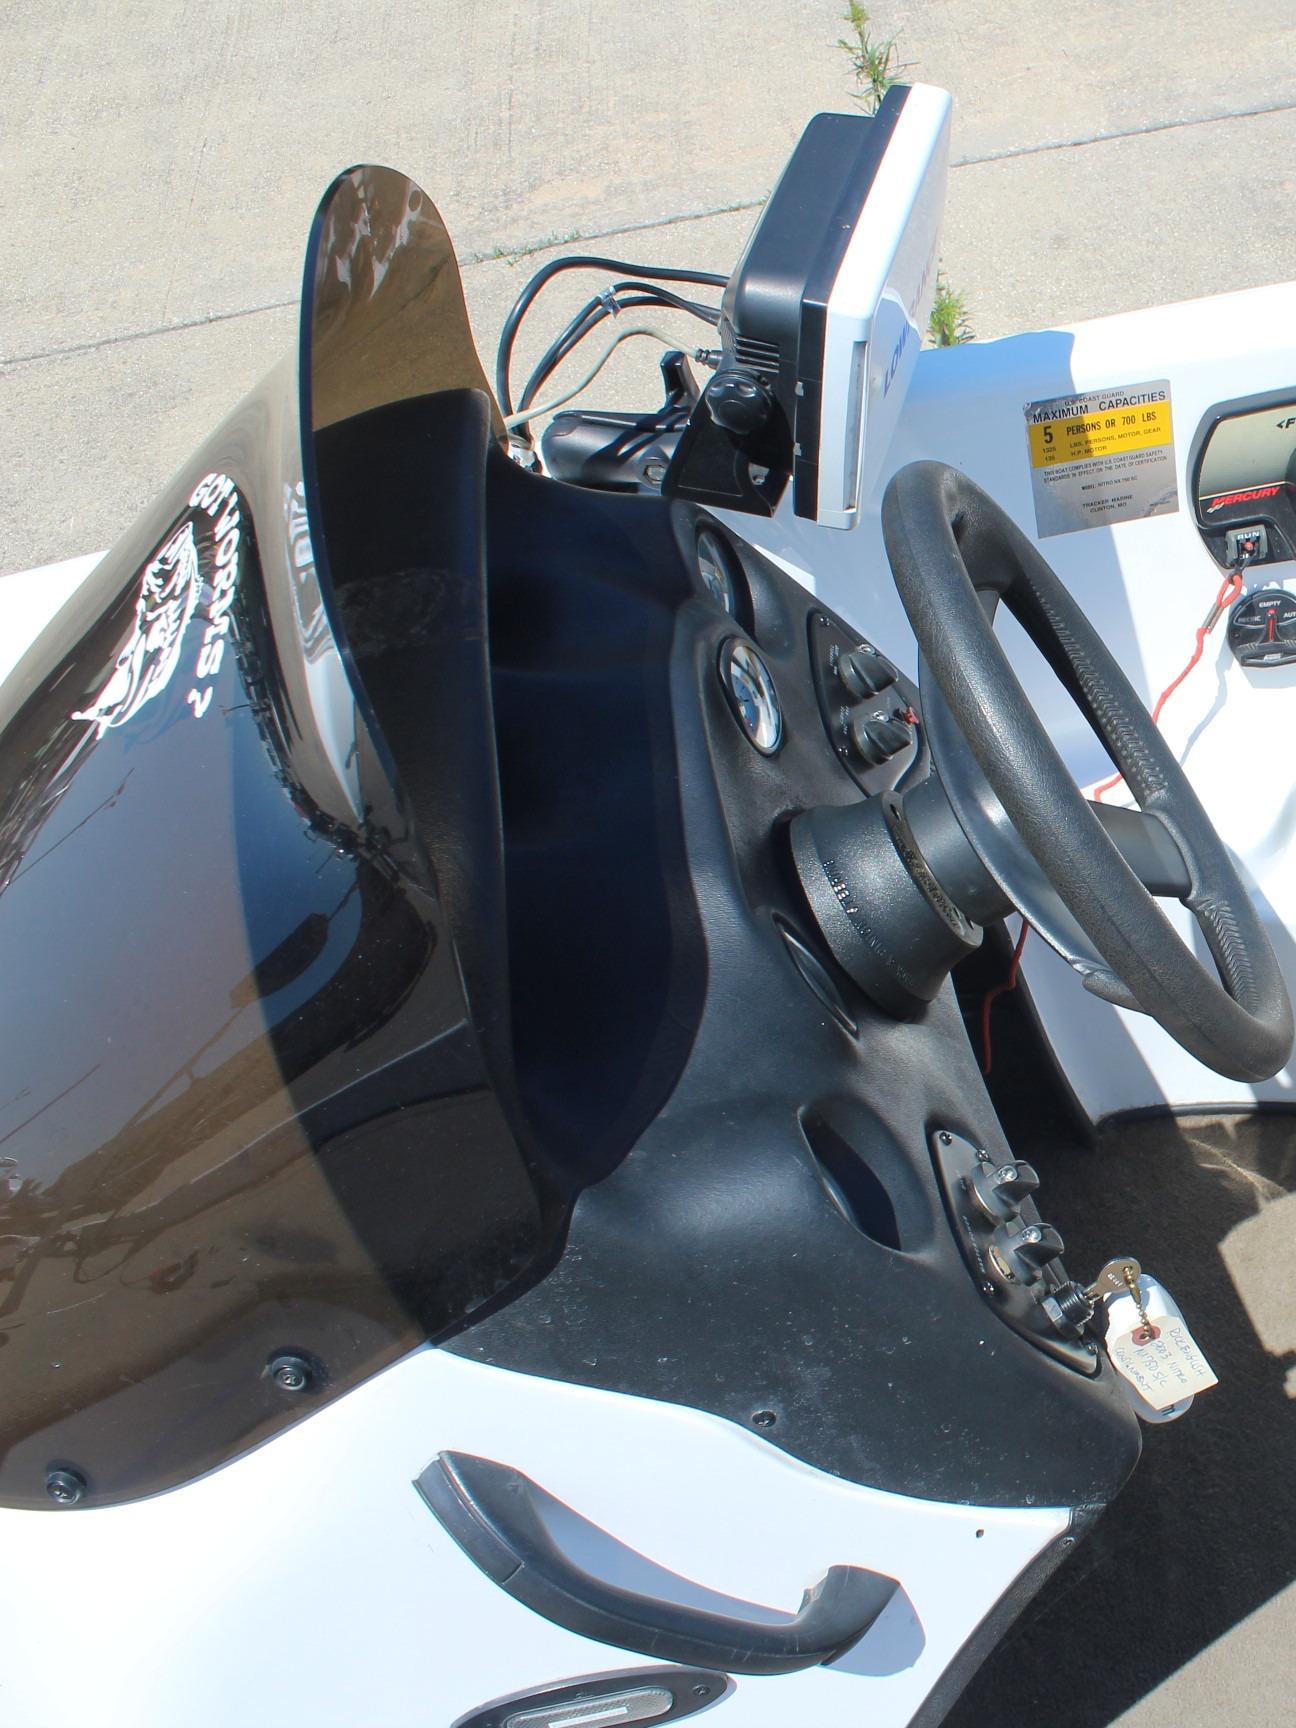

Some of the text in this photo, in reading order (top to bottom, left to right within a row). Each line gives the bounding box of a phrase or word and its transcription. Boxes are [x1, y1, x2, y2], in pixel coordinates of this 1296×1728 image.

[1032, 390, 1165, 423] MAXIMUM CAPACITIES
[1078, 395, 1099, 403] COAST
[1101, 391, 1124, 399] GUARD
[1042, 411, 1156, 444] 5 PERSONS OR 700 LBS
[188, 473, 235, 516] GOT
[1212, 486, 1280, 506] MERCURY
[1237, 530, 1260, 541] RUN
[1258, 600, 1281, 608] EMPTY
